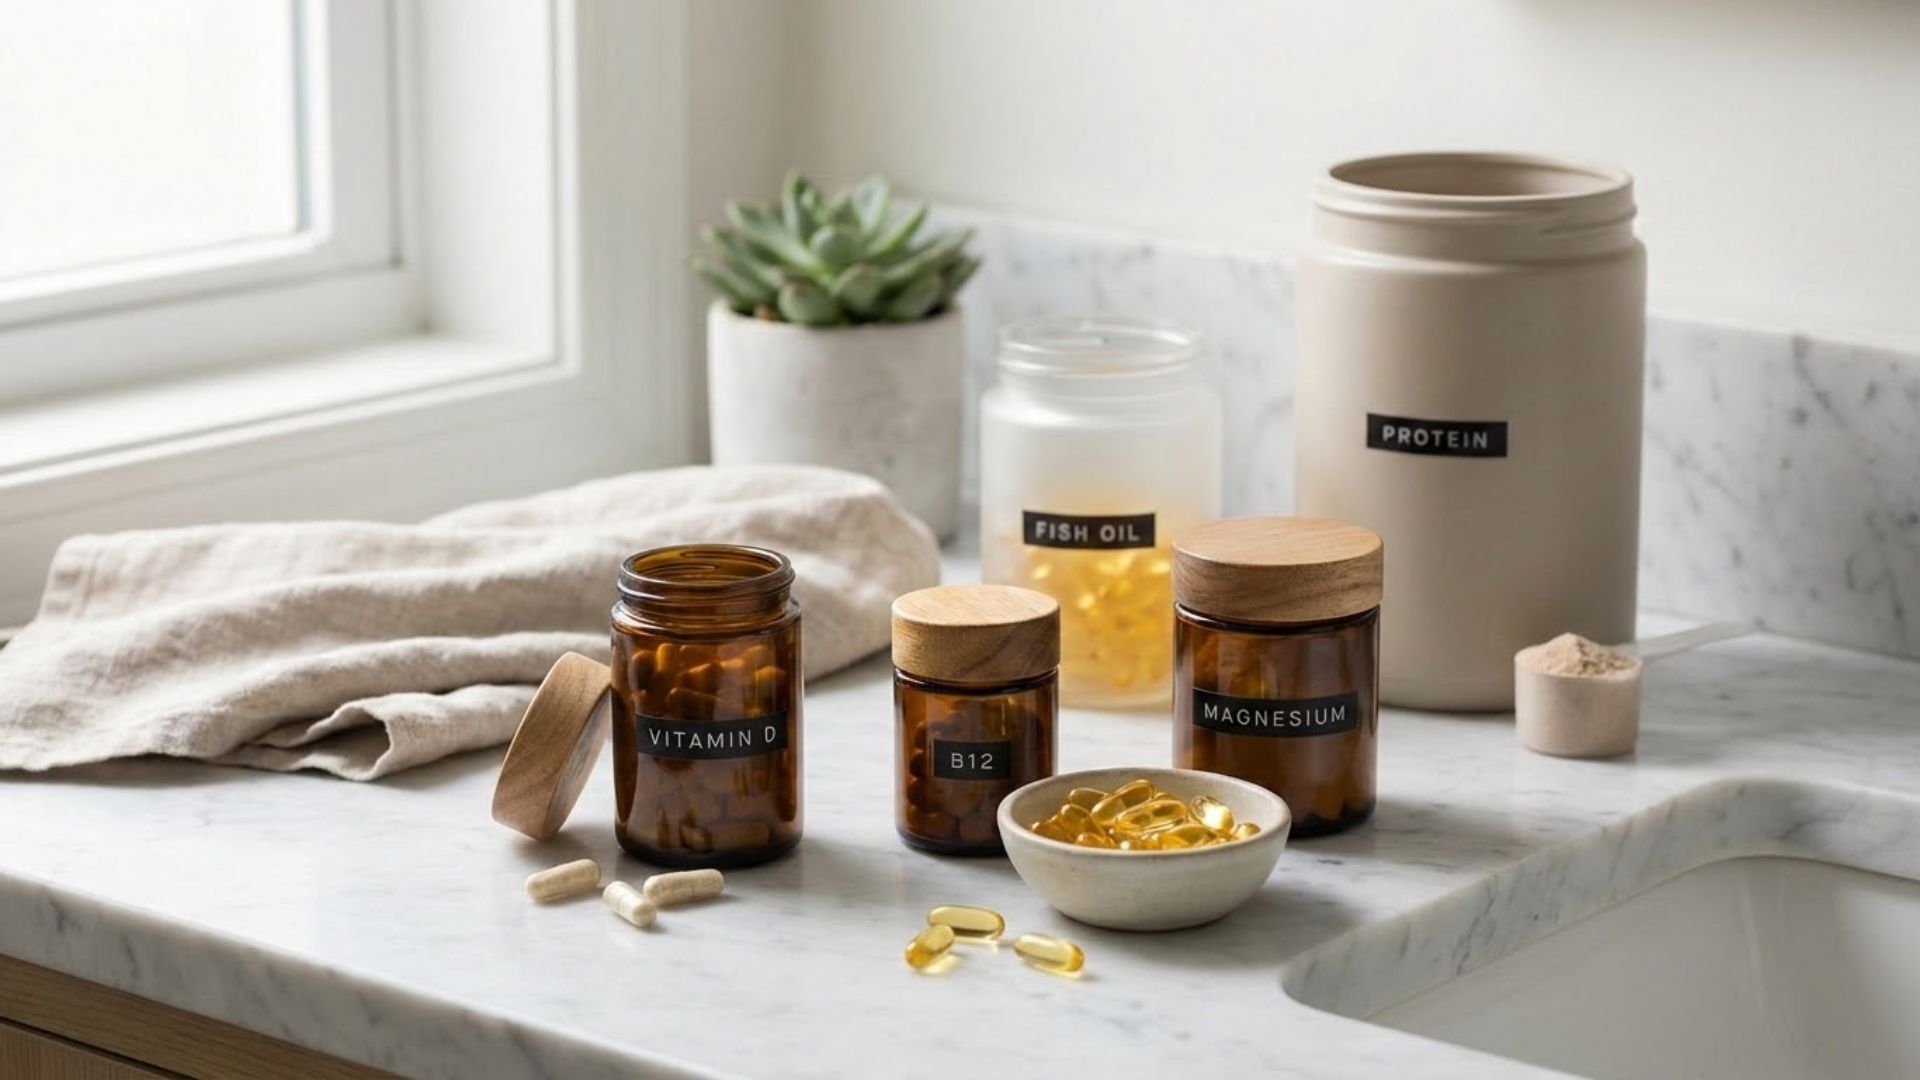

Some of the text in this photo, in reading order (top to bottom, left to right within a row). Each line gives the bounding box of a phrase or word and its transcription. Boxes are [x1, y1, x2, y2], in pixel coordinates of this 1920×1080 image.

[1382, 424, 1488, 449] PROTEIN
[1035, 521, 1140, 542] FISH OIL
[1204, 702, 1345, 727] MAGNESIUM
[649, 725, 776, 749] VITAMIN D
[951, 752, 993, 770] B12
